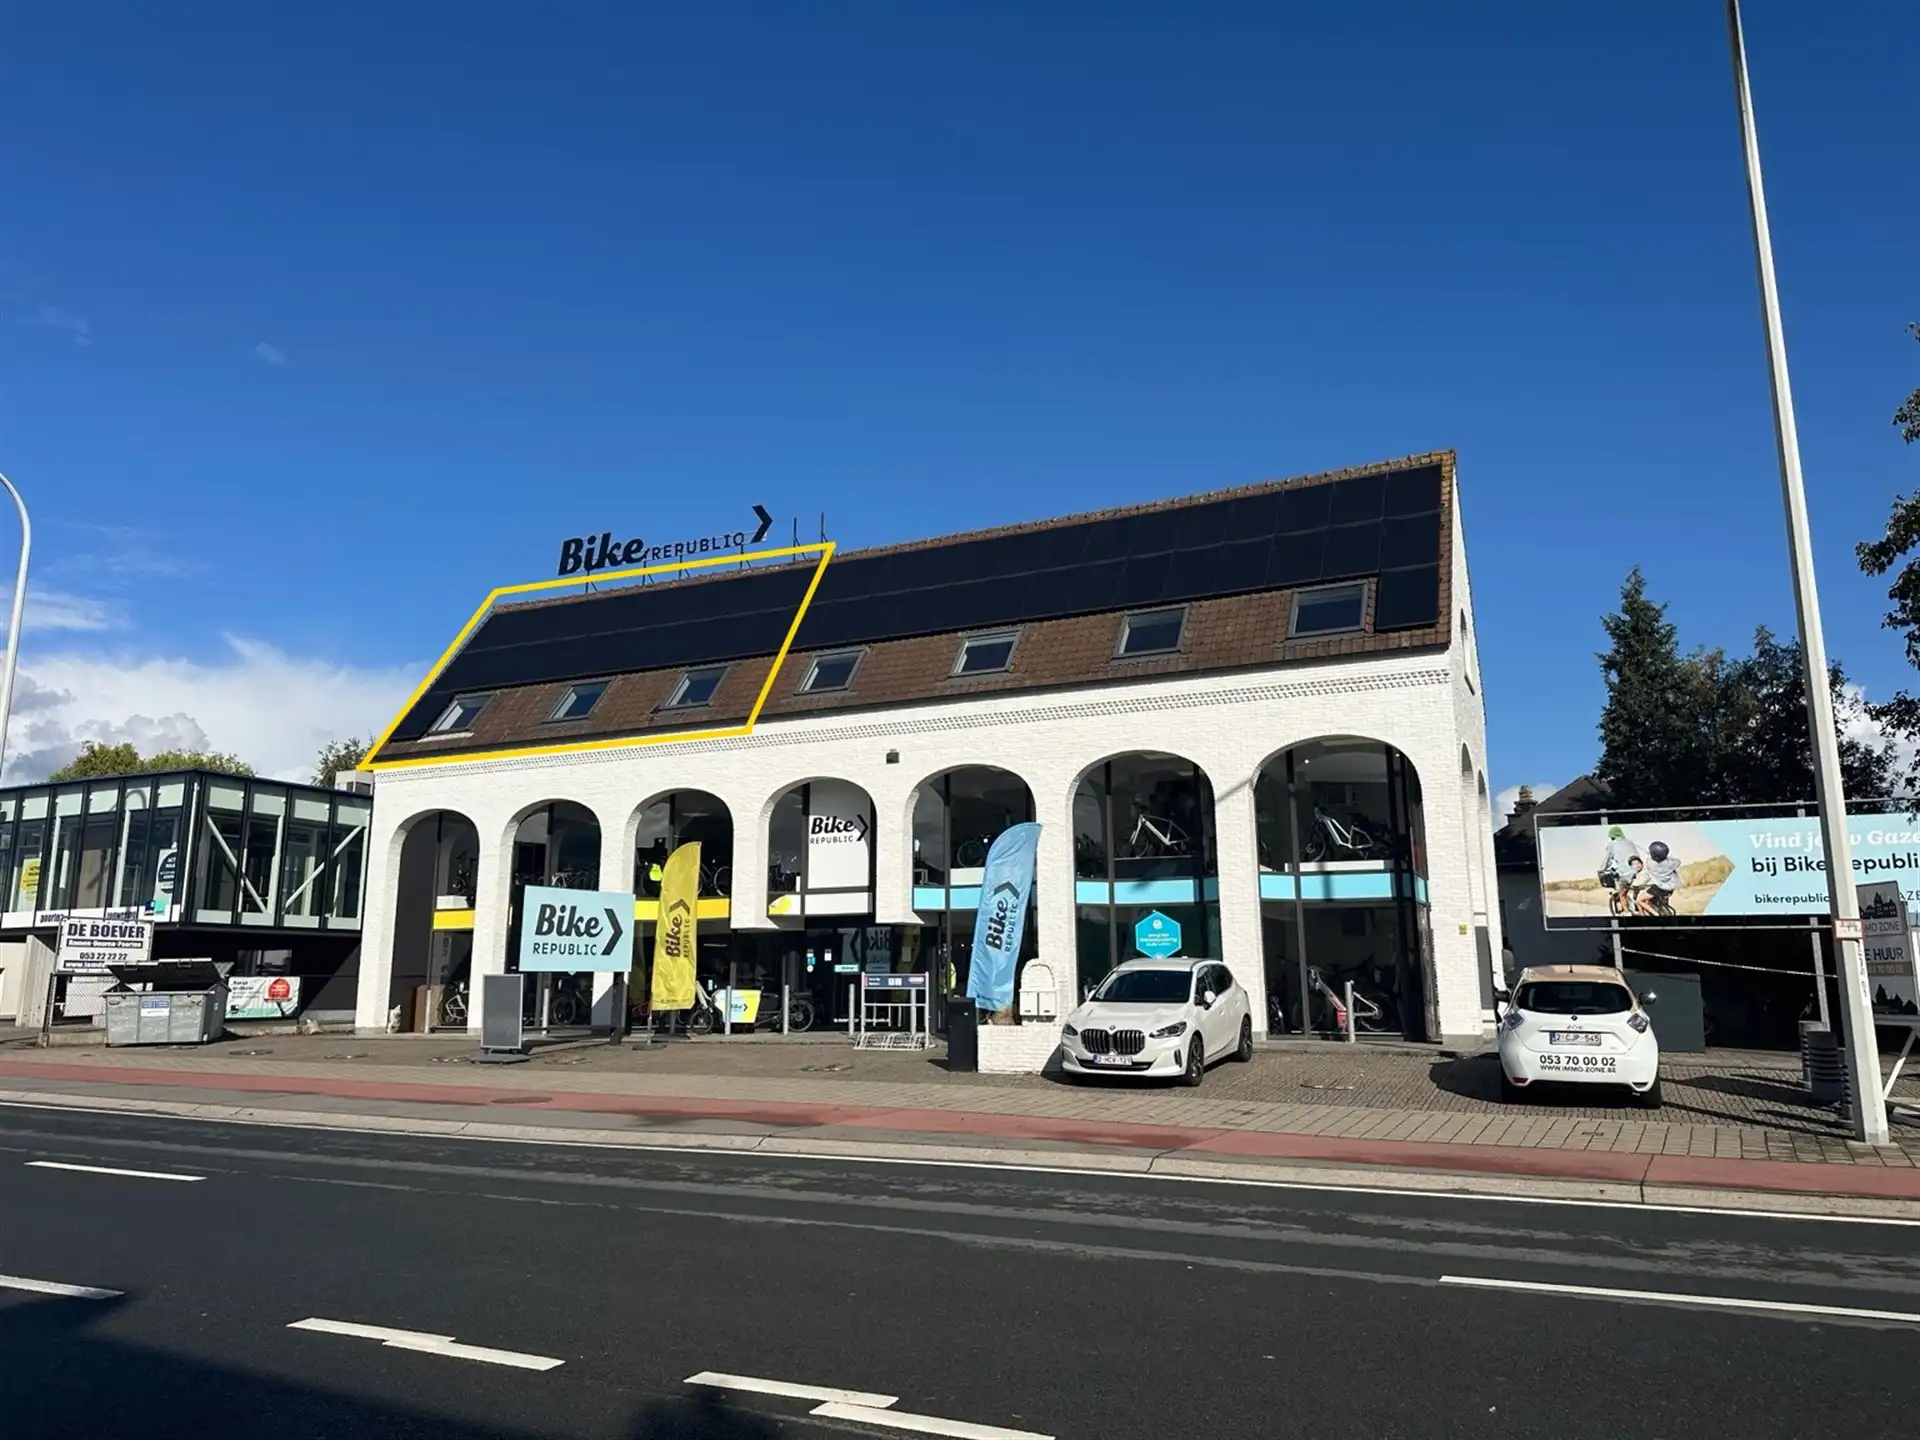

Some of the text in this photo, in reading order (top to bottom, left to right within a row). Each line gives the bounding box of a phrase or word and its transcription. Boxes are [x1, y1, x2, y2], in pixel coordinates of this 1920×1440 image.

[558, 532, 650, 576] Bike
[811, 816, 857, 834] Bike
[810, 835, 853, 844] REPUBLIC
[1749, 831, 1801, 849] Vind
[1751, 856, 1777, 877] bij
[1784, 855, 1827, 872] Bike
[535, 903, 604, 938] Bike
[985, 897, 1009, 951] Bike
[1005, 903, 1019, 952] REPUBLIC
[1879, 921, 1900, 932] ZONE
[67, 923, 145, 939] DE BOEVER
[665, 913, 683, 957] Bike
[80, 952, 95, 960] 053
[532, 942, 598, 956] REPUBLIC
[1873, 947, 1904, 961] HUUR
[1540, 1055, 1616, 1067] 053 70 00 02
